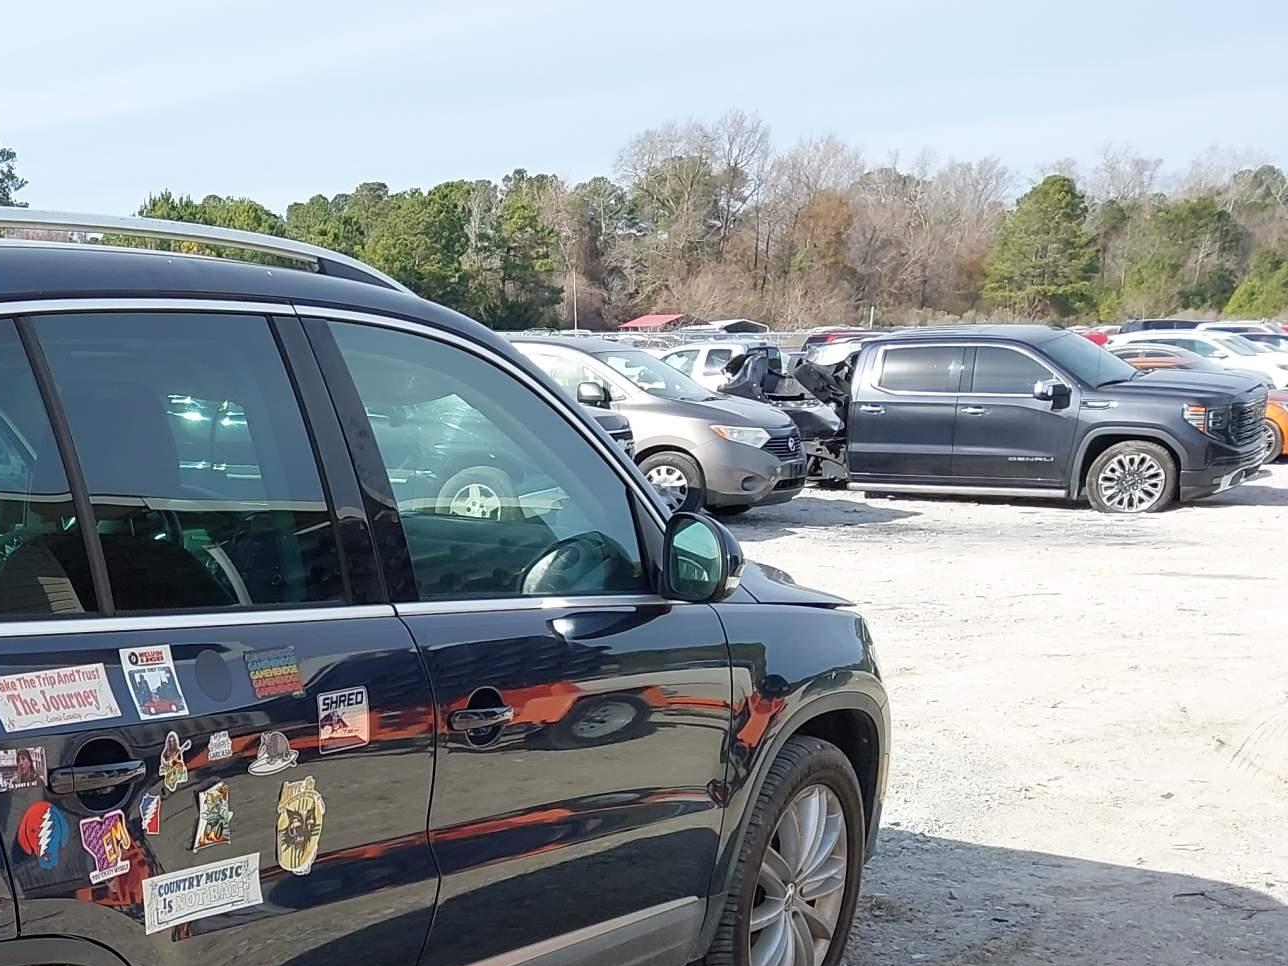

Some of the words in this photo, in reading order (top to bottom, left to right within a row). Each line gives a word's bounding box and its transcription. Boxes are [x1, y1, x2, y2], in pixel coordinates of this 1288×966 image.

[17, 677, 37, 689] The
[36, 673, 57, 689] Trip
[57, 670, 77, 684] And
[76, 667, 100, 681] Trust
[7, 693, 41, 716] The
[40, 688, 101, 713] Journey
[322, 691, 363, 711] SHRED
[158, 874, 203, 897] COUNTRY
[205, 865, 242, 884] MUSIC
[176, 889, 207, 911] NOT
[209, 880, 240, 903] BAD
